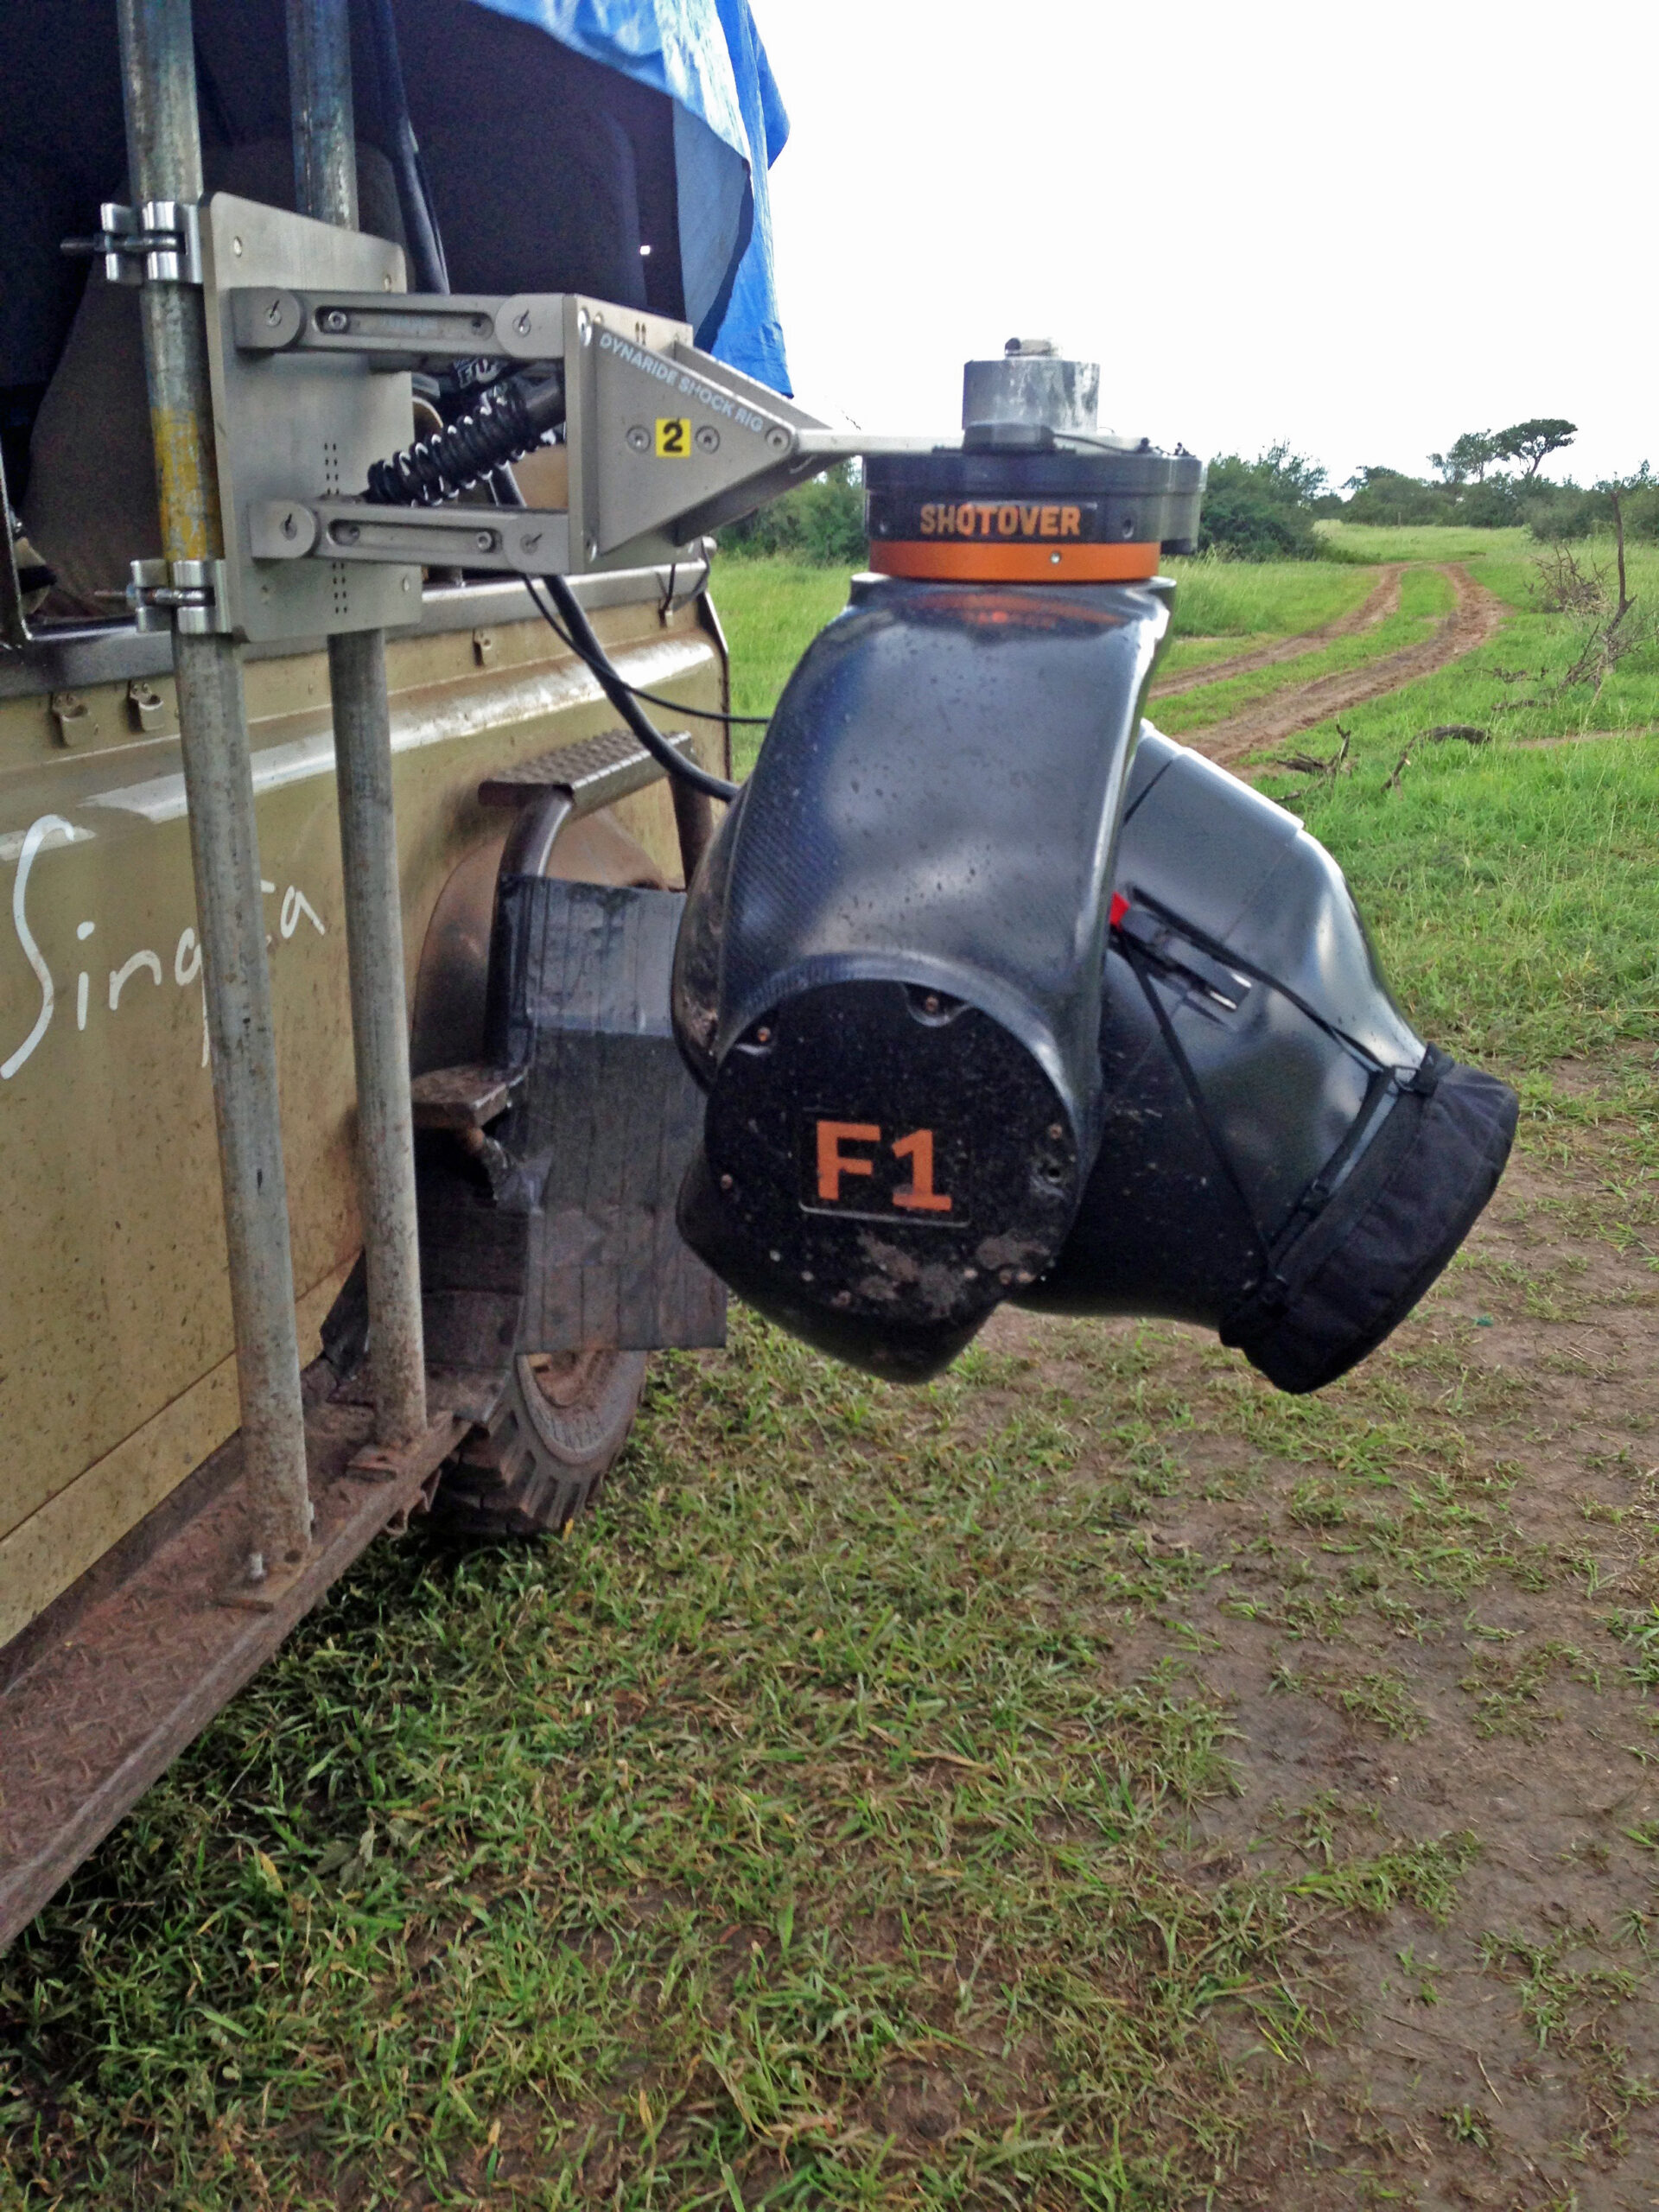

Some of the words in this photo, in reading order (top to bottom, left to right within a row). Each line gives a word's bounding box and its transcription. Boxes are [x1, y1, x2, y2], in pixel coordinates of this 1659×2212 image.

[600, 332, 678, 386] DYNARIDE
[678, 376, 732, 417] SHOCK
[734, 407, 764, 432] RIG
[663, 421, 683, 453] 2
[920, 503, 1081, 536] SHOTOVER
[817, 1120, 952, 1211] F1
